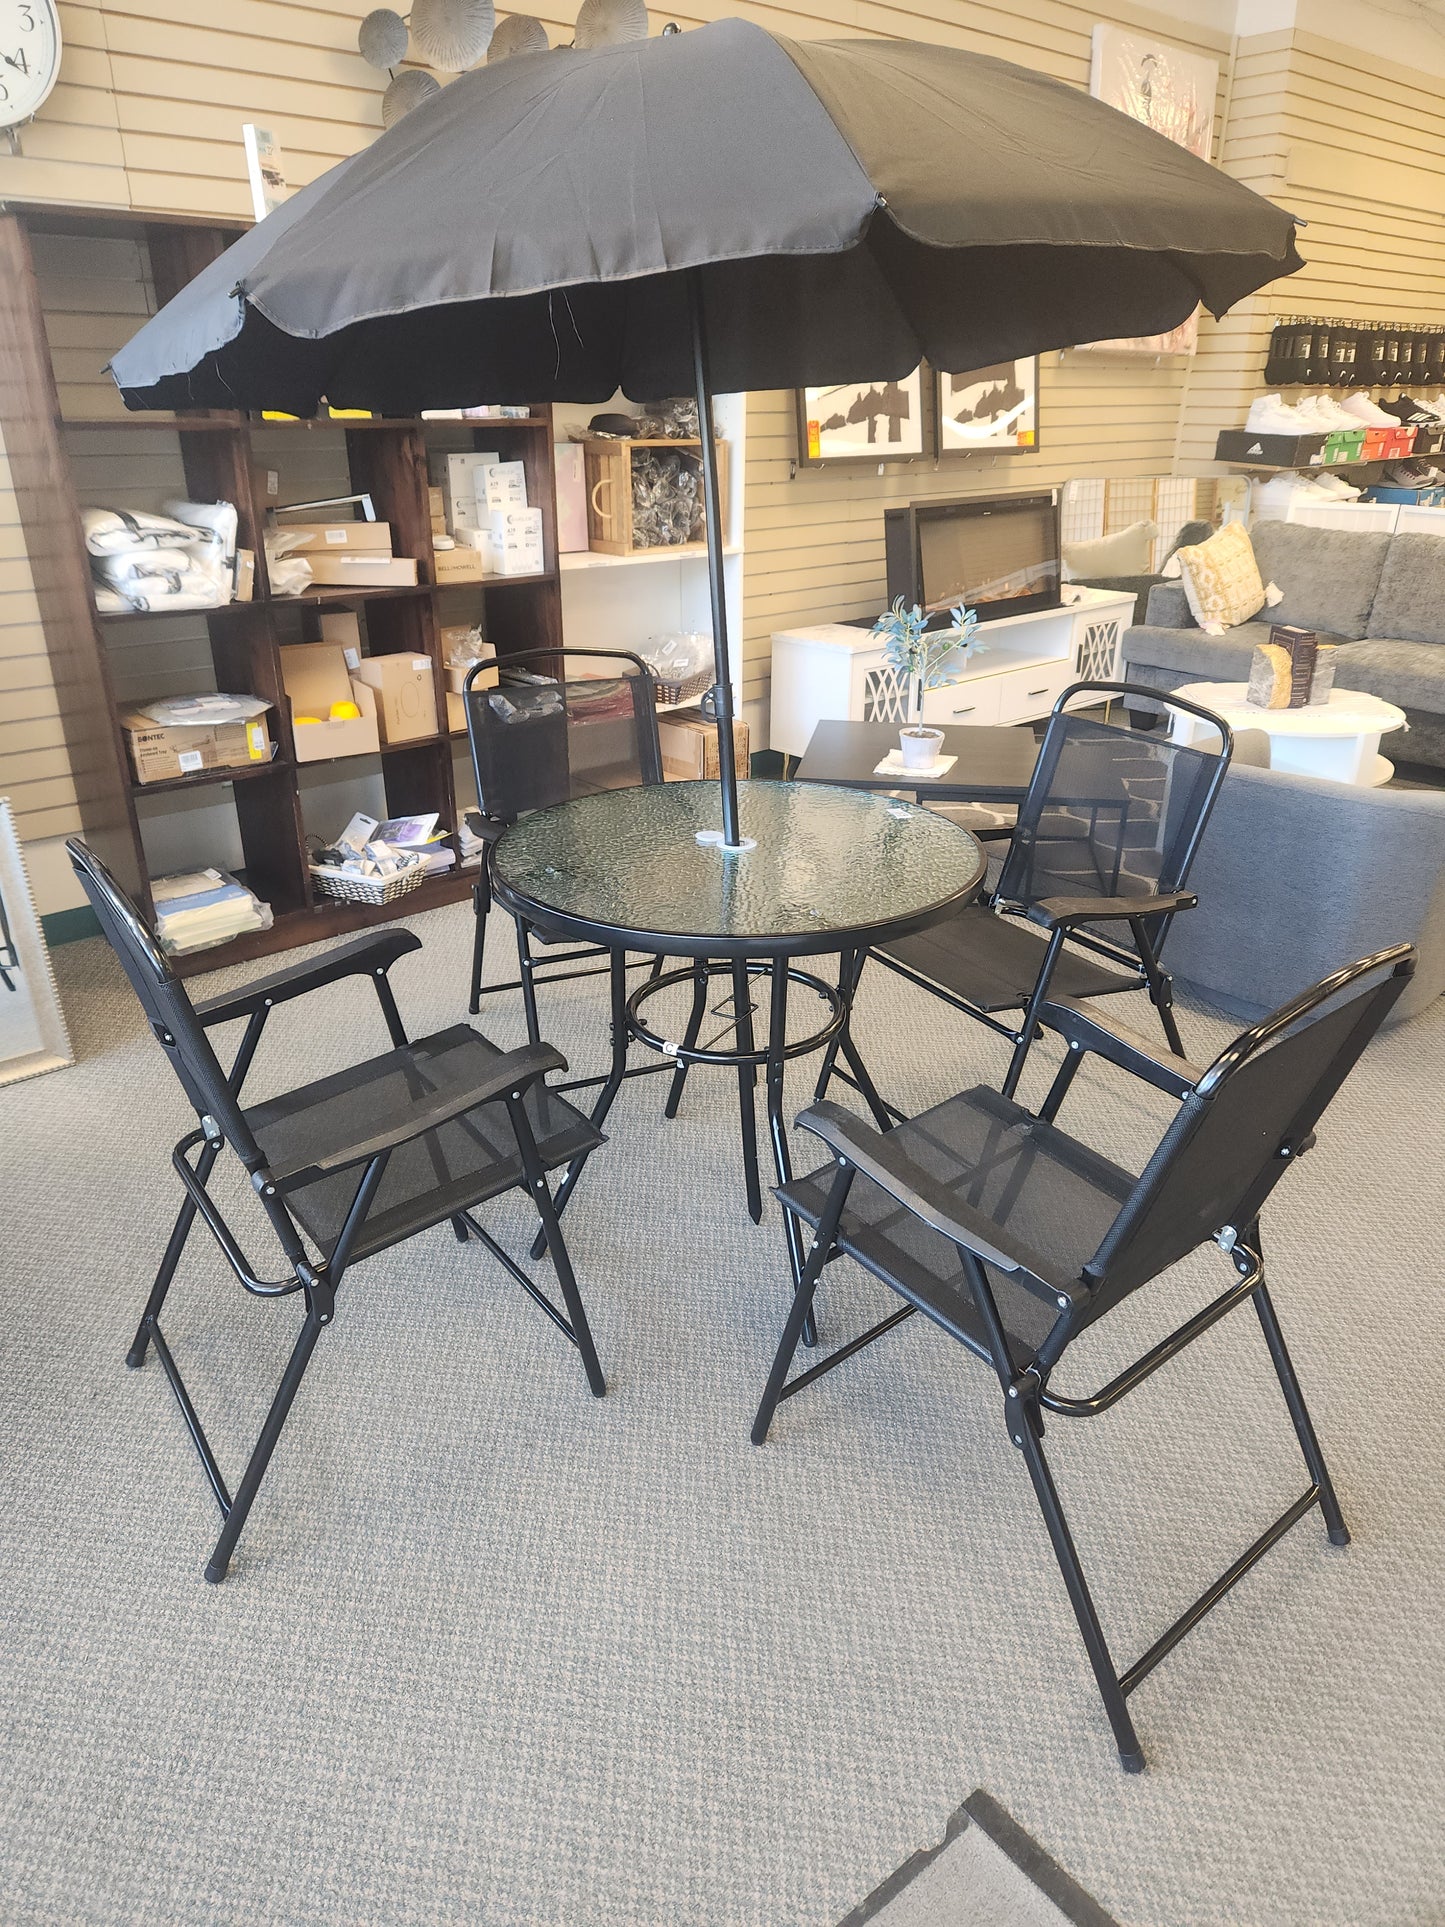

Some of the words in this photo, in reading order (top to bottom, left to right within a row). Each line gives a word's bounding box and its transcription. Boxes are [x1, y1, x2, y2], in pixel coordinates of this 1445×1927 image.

[17, 4, 35, 32] 3
[12, 47, 31, 74] 4
[665, 1044, 674, 1053] C
